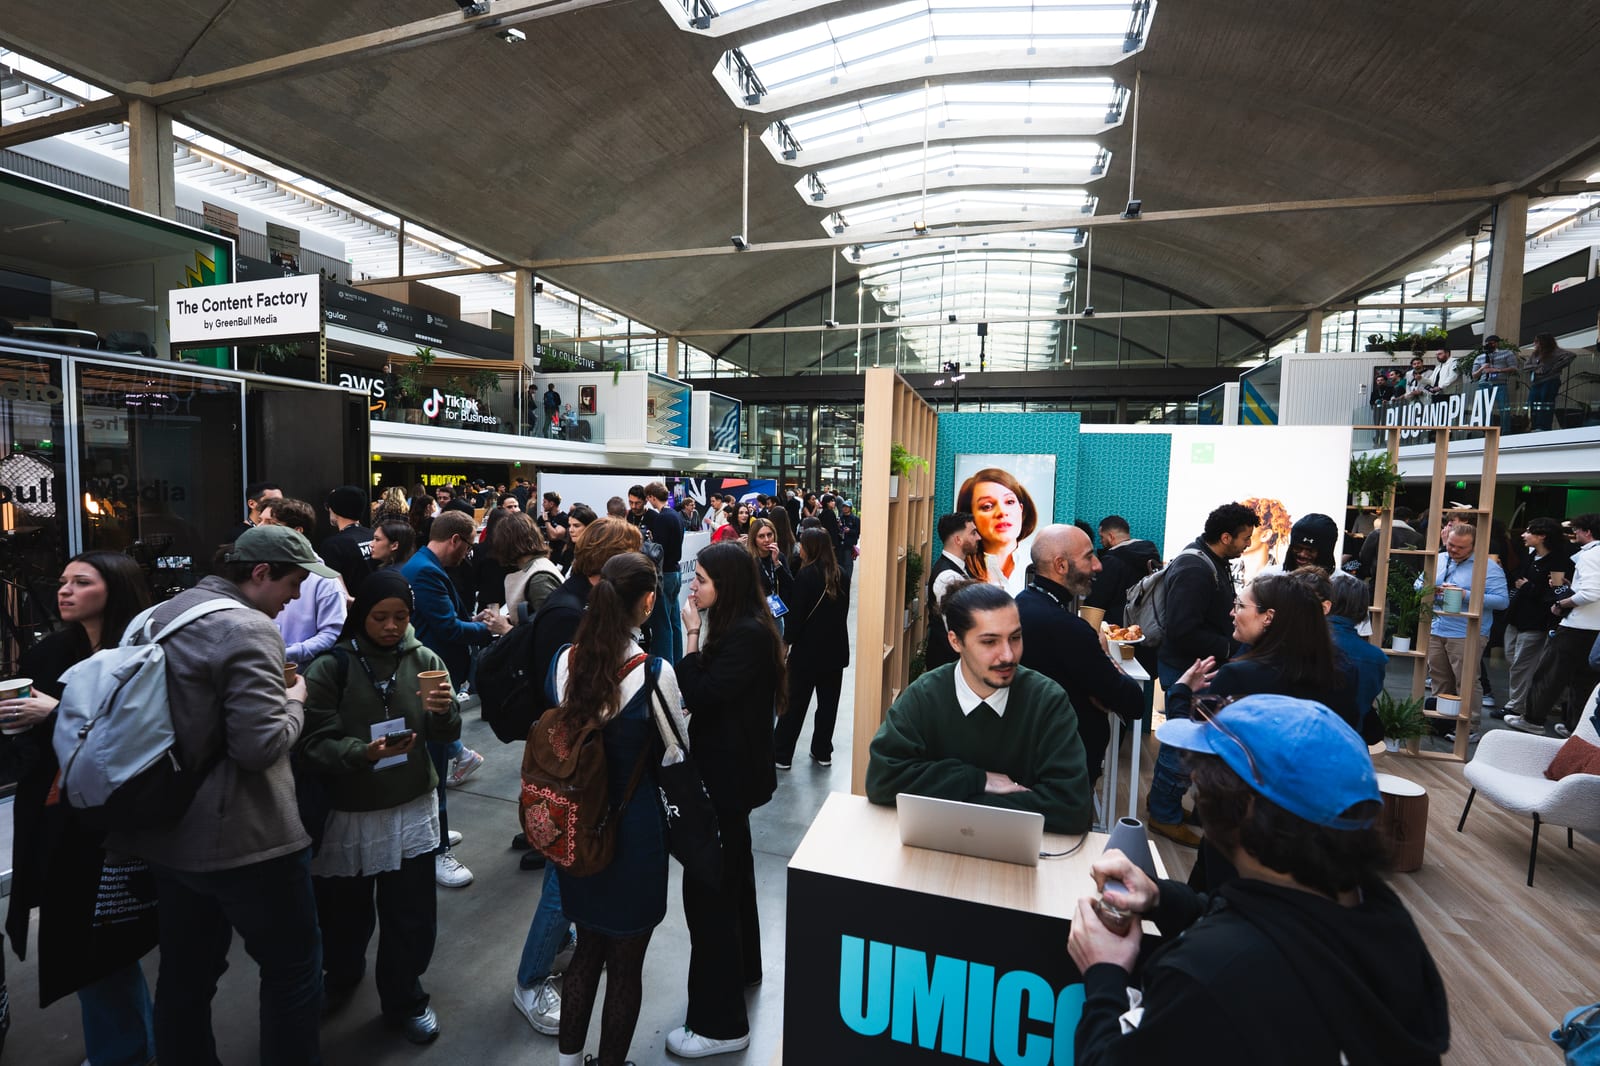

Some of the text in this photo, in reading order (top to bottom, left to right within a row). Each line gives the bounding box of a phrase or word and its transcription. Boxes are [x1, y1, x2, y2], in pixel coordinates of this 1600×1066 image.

[177, 291, 308, 315] The Content Factory
[204, 314, 278, 331] by GreenBull Media
[559, 351, 596, 369] COLLECTIVE
[339, 373, 385, 398] aws
[445, 394, 479, 410] TikTok
[445, 409, 497, 425] for Business
